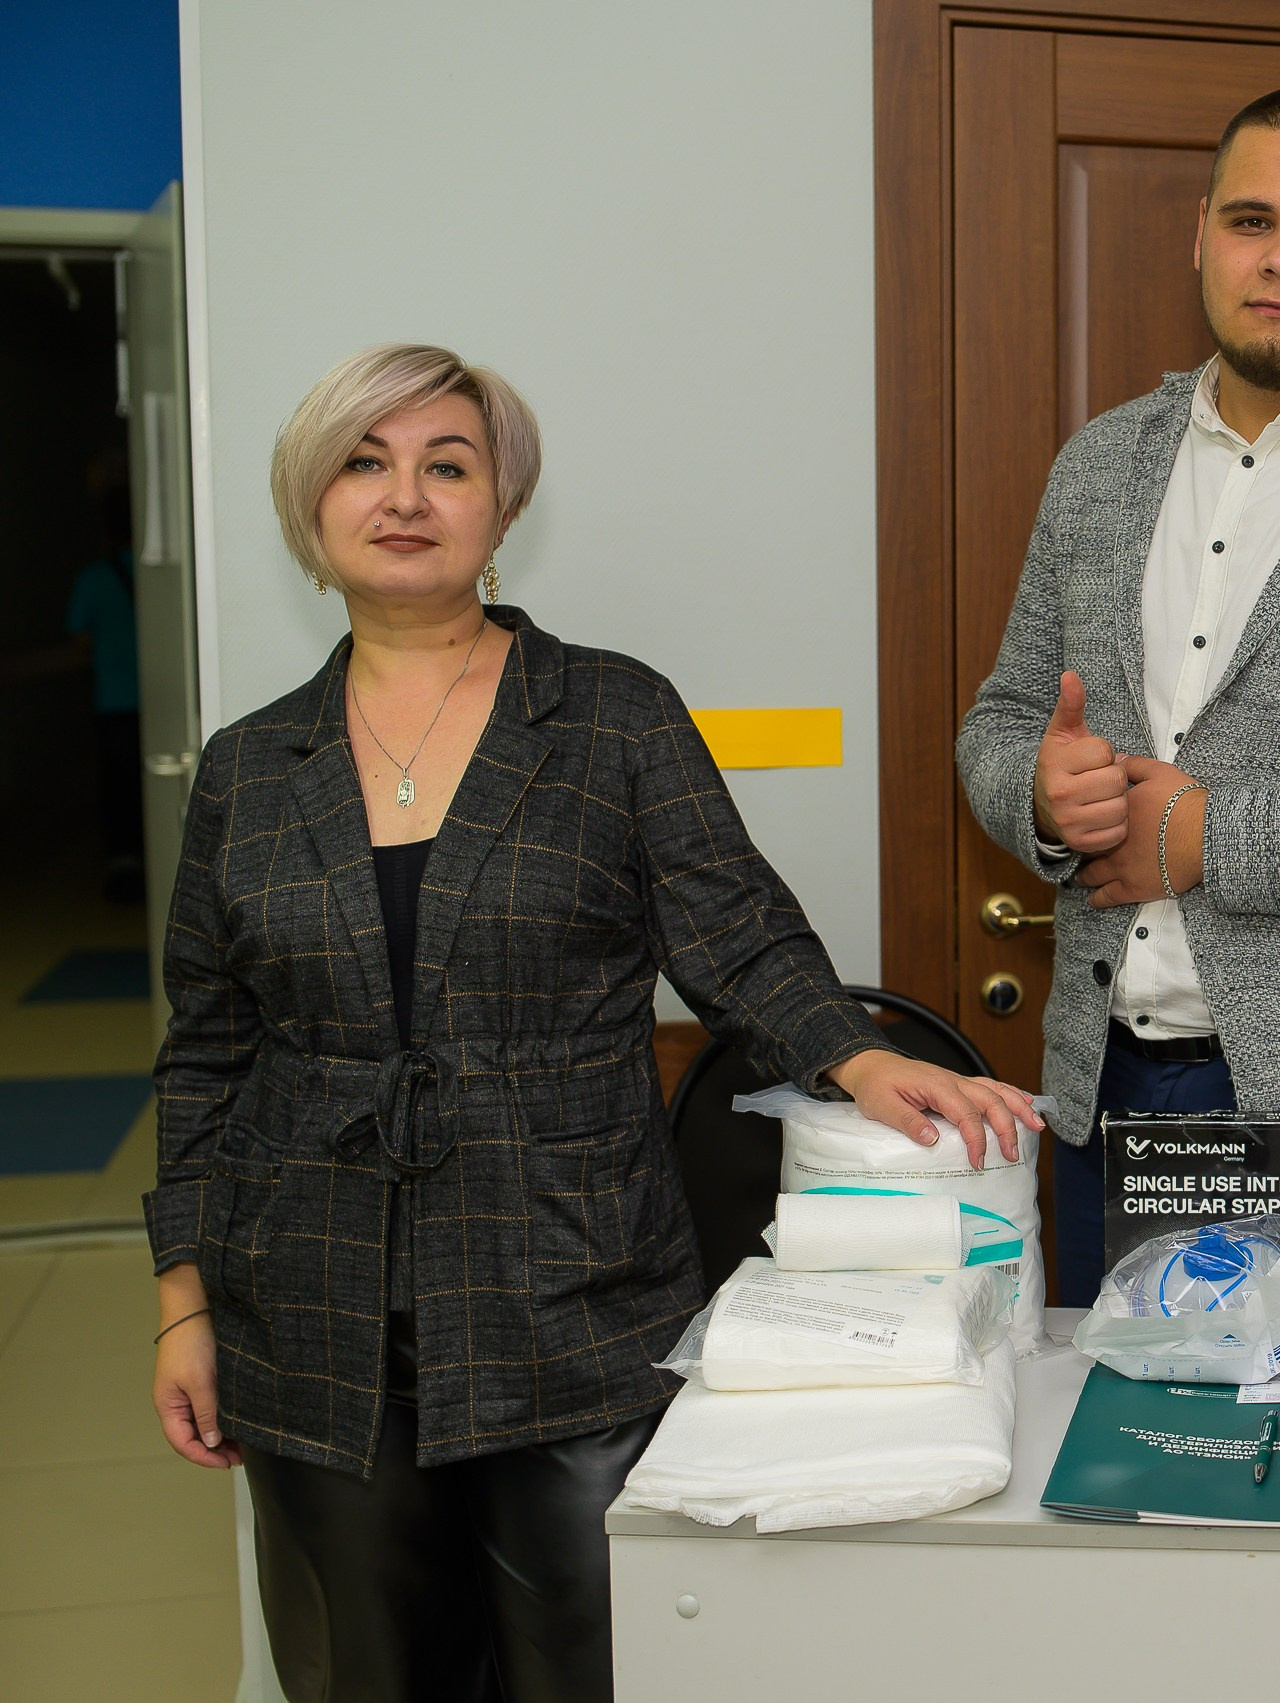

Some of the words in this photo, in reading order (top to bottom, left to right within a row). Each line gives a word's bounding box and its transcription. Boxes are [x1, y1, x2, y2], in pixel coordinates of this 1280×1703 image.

[1153, 1143, 1246, 1155] VOLKMANN
[1123, 1176, 1196, 1192] SINGLE
[1201, 1176, 1243, 1192] USE
[1123, 1198, 1226, 1214] CIRCULAR
[1119, 1426, 1184, 1439] КАТАЛОГ
[1136, 1434, 1166, 1443] ДЛЯ
[1161, 1442, 1259, 1456] ДЕЗИНФЕКЦИ
